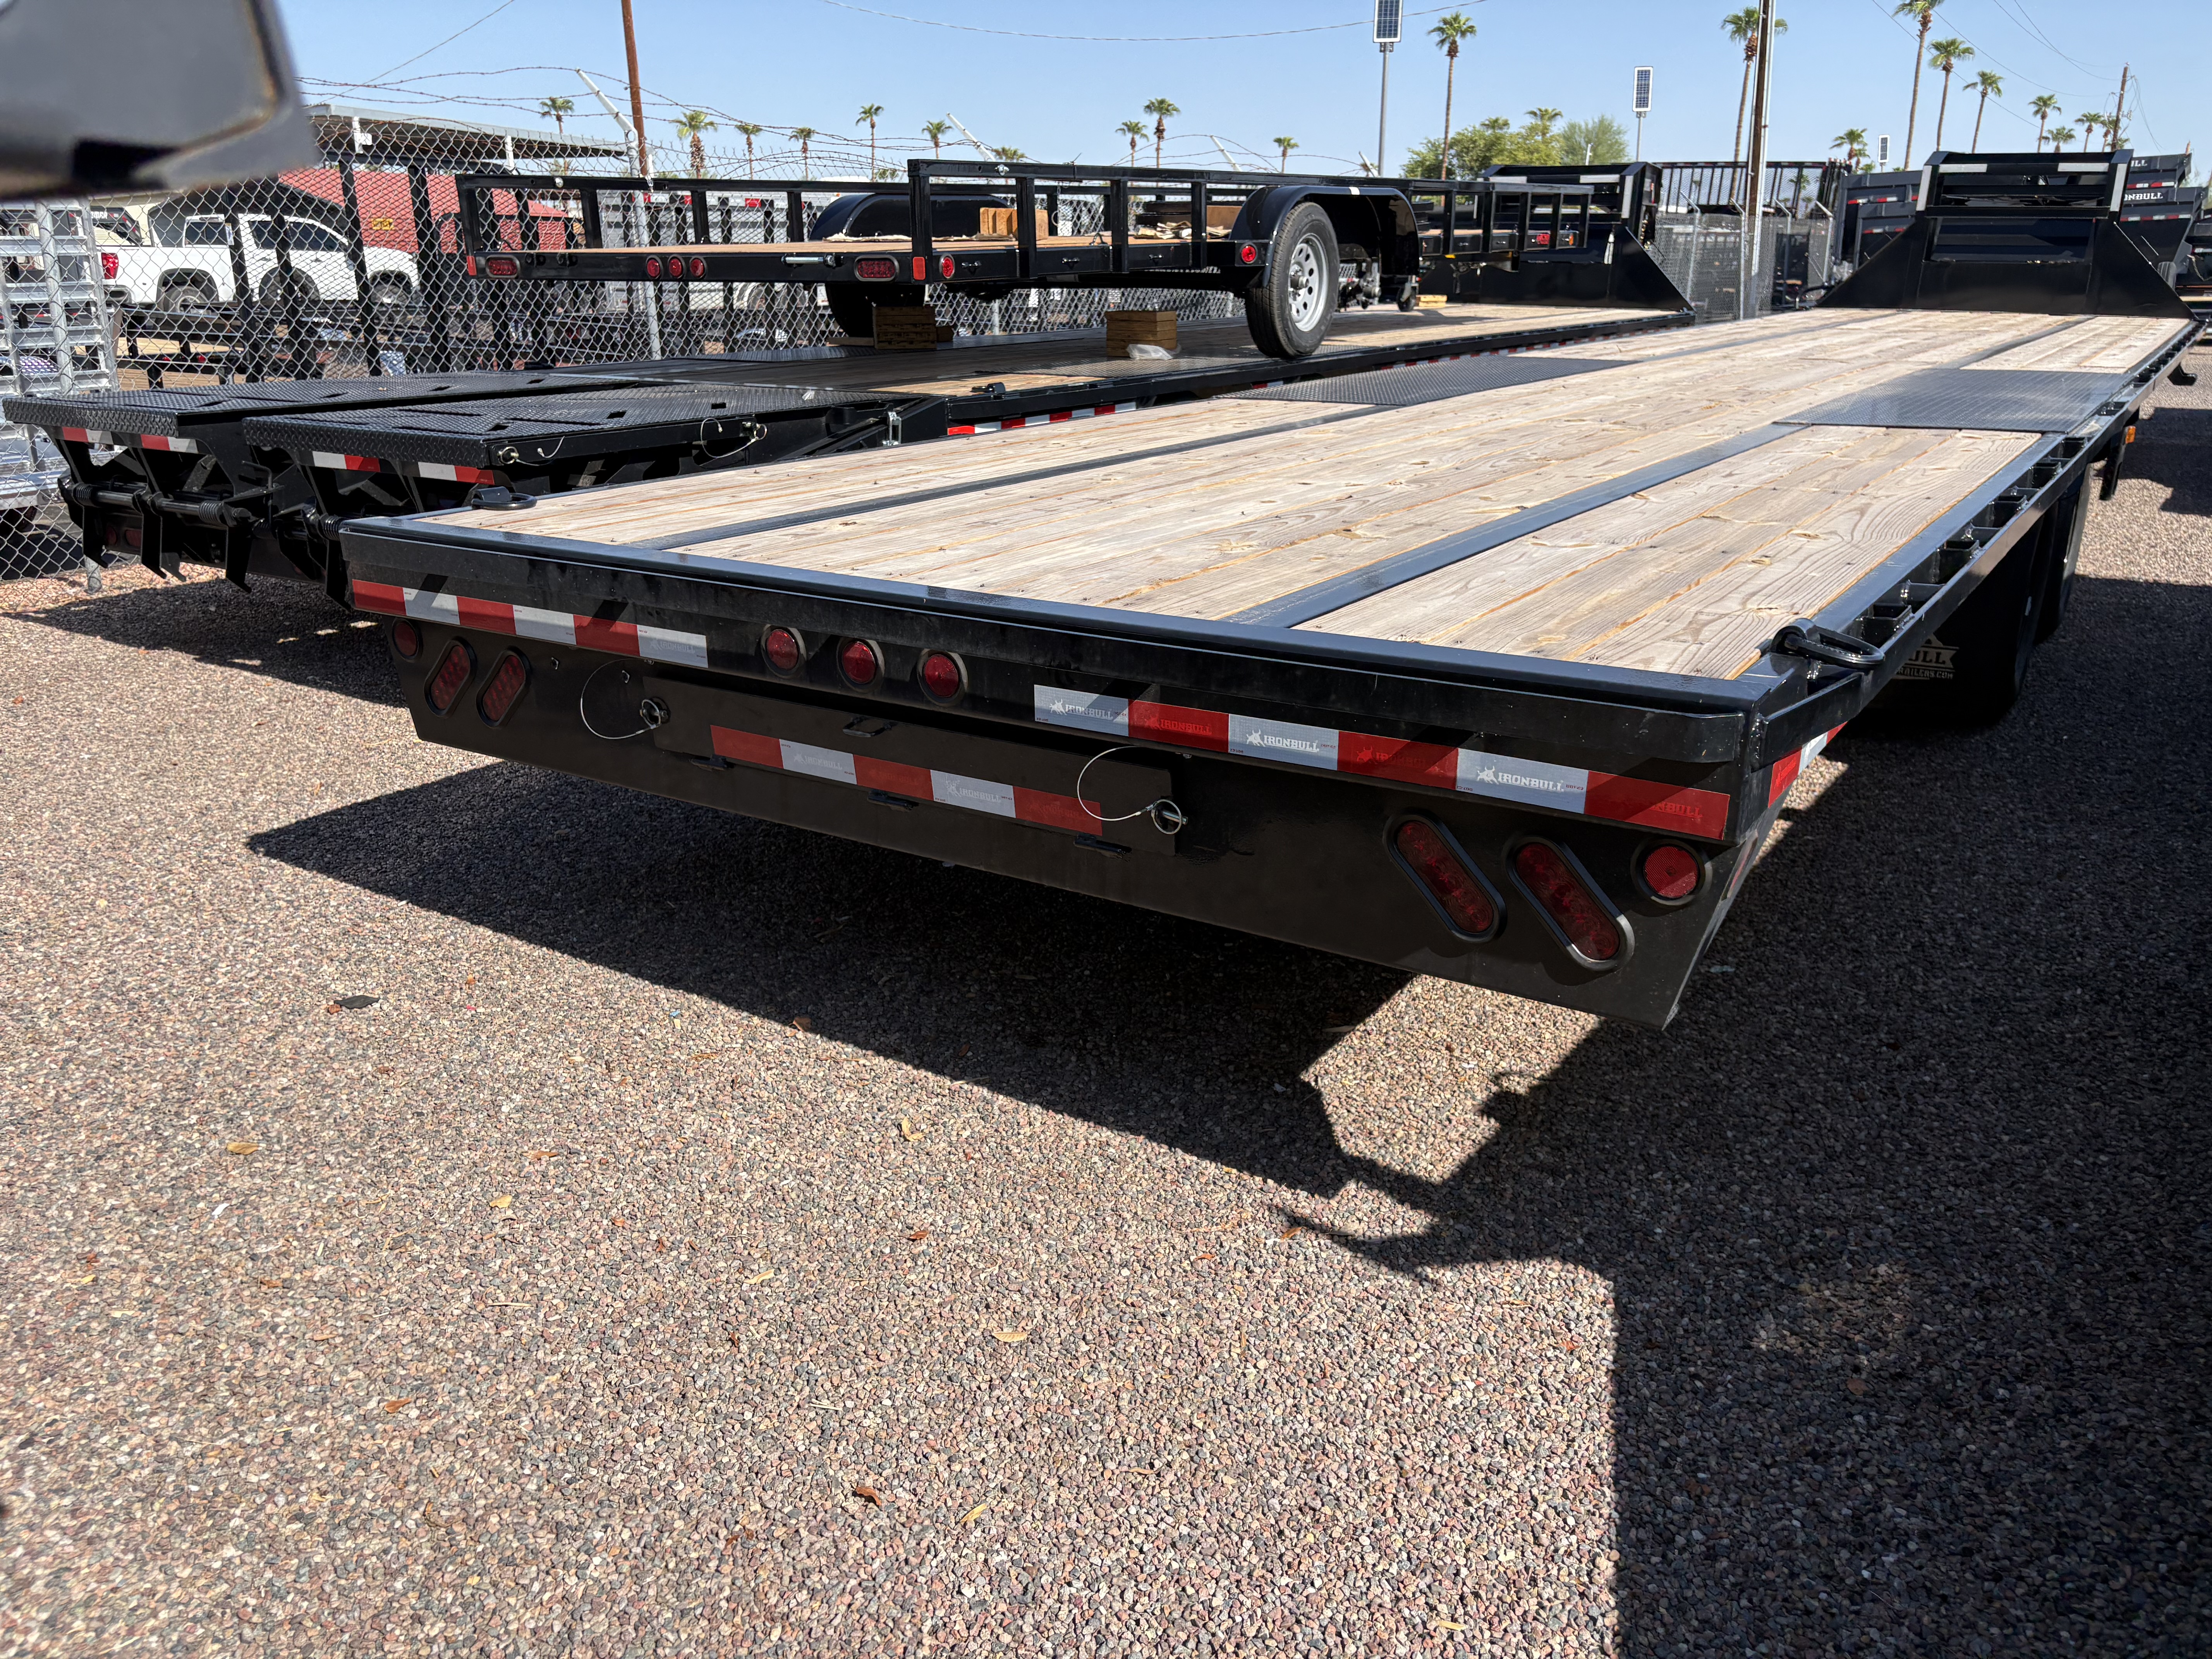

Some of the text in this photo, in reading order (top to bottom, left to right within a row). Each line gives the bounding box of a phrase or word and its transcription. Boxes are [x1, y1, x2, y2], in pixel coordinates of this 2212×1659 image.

[1065, 704, 1114, 720] IRONBULL
[1160, 719, 1212, 735] IRONBULL
[1264, 735, 1320, 752] IRONBULL
[1498, 772, 1564, 792] IRONBULL
[959, 787, 1001, 804] IRONBULL
